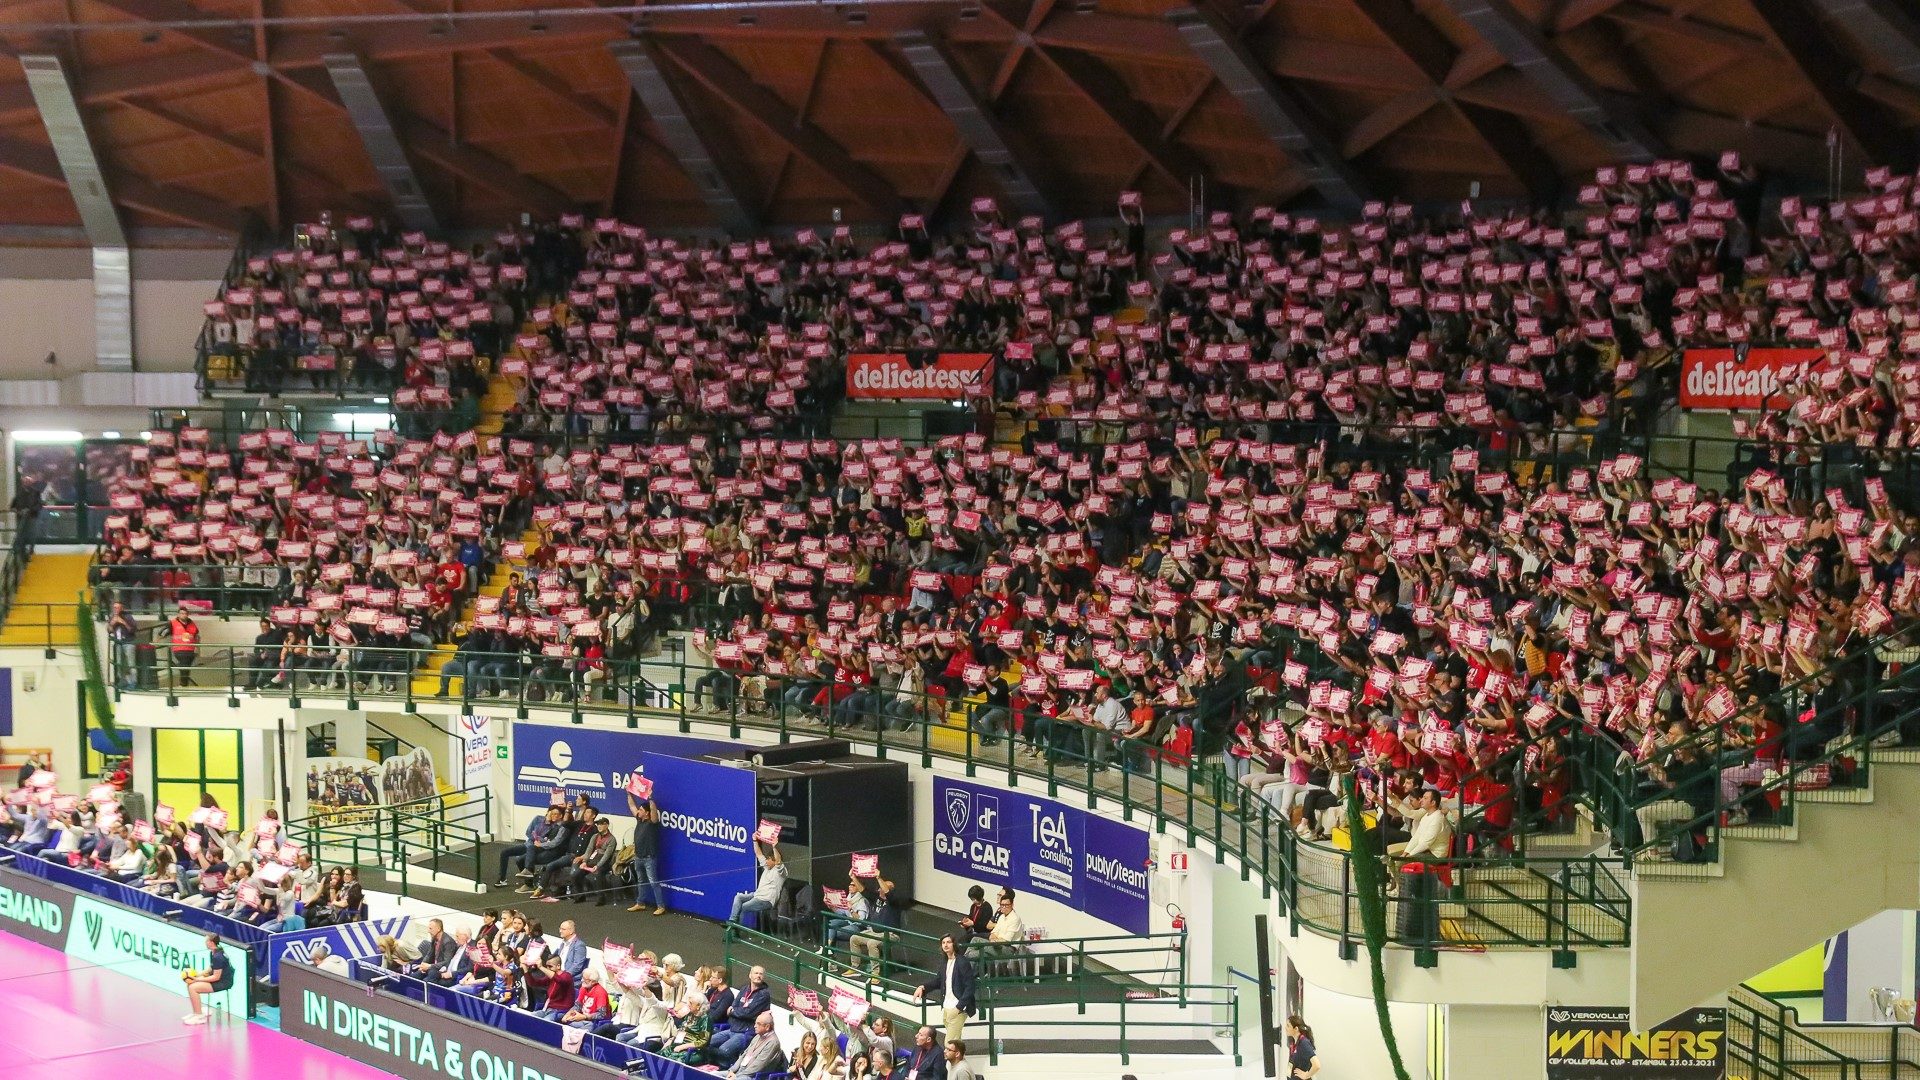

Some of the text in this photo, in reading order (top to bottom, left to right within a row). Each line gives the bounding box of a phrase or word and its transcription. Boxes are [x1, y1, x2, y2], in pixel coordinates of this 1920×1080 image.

[466, 735, 488, 751] VERO
[465, 748, 491, 766] OLLEY
[657, 809, 748, 843] esopositivo
[935, 833, 967, 858] G.P.
[1040, 848, 1073, 872] consulting
[303, 989, 515, 1080] IN DIRETTA & ON
[1549, 1029, 1724, 1059] WINNERS
